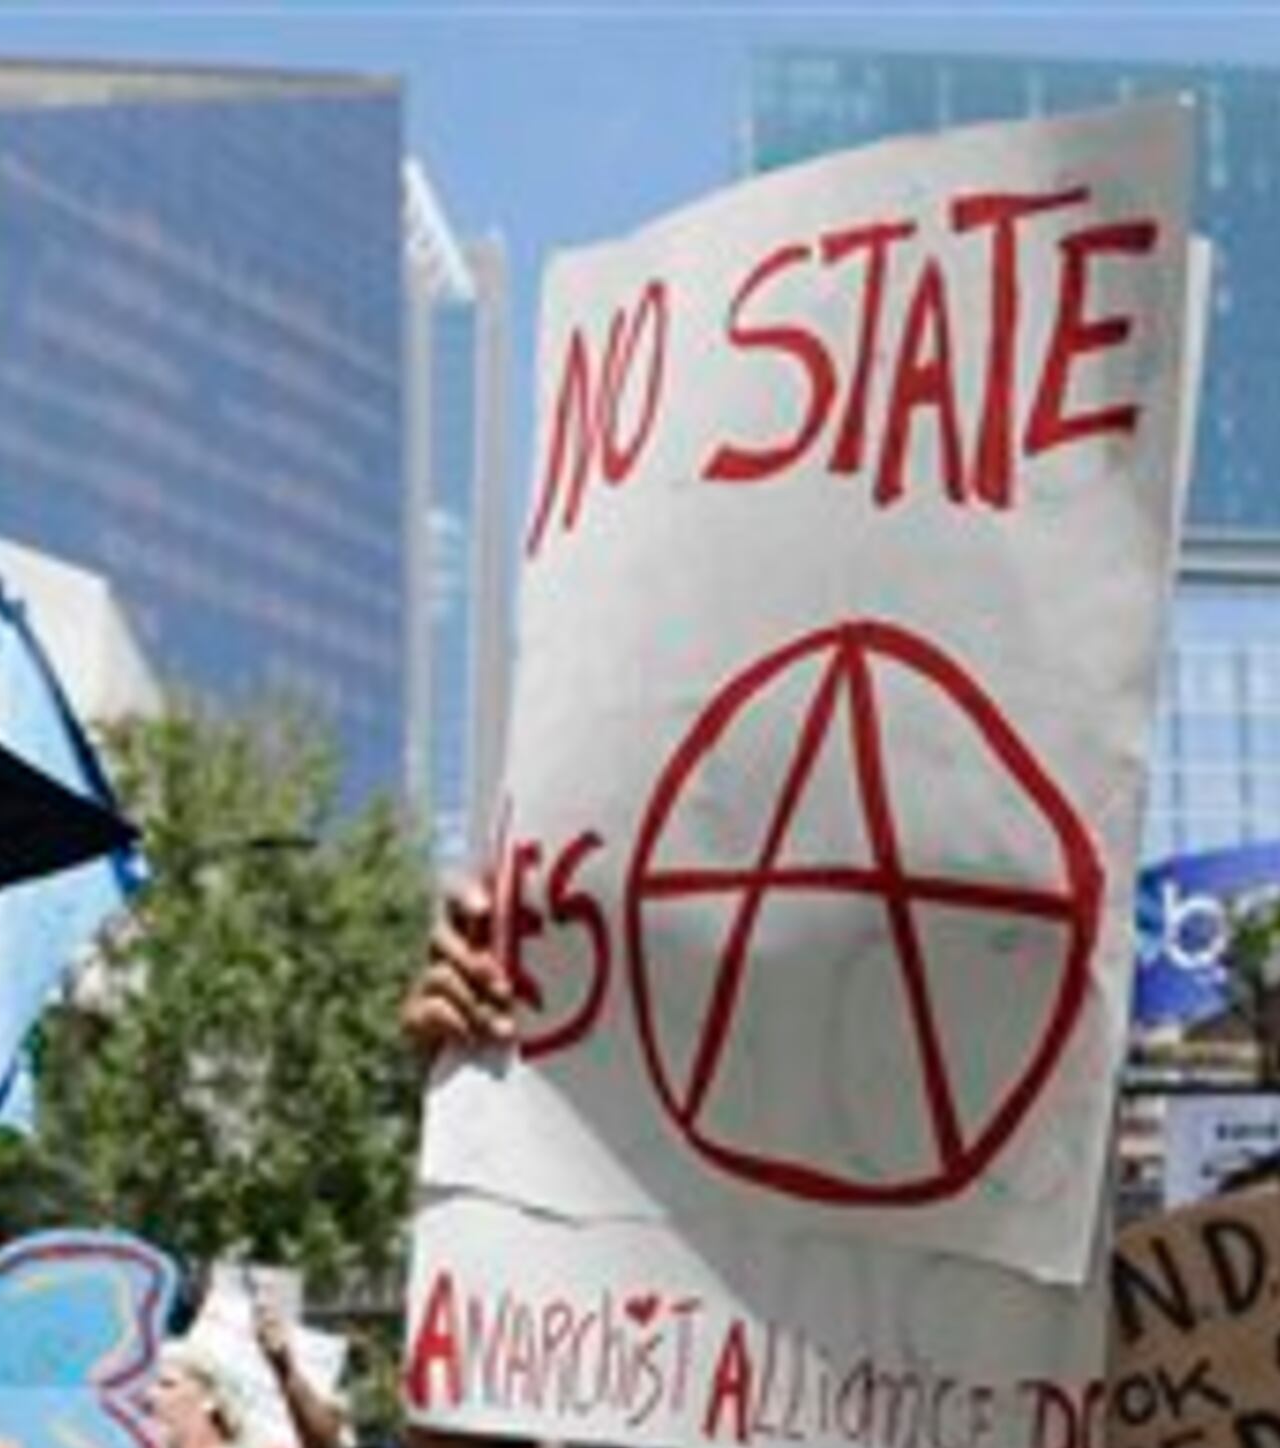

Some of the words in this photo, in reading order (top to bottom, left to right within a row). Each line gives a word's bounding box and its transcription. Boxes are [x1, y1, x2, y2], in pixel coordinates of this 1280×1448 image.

[525, 280, 669, 558] NO
[700, 186, 1157, 509] STATE
[502, 828, 612, 1060] ES
